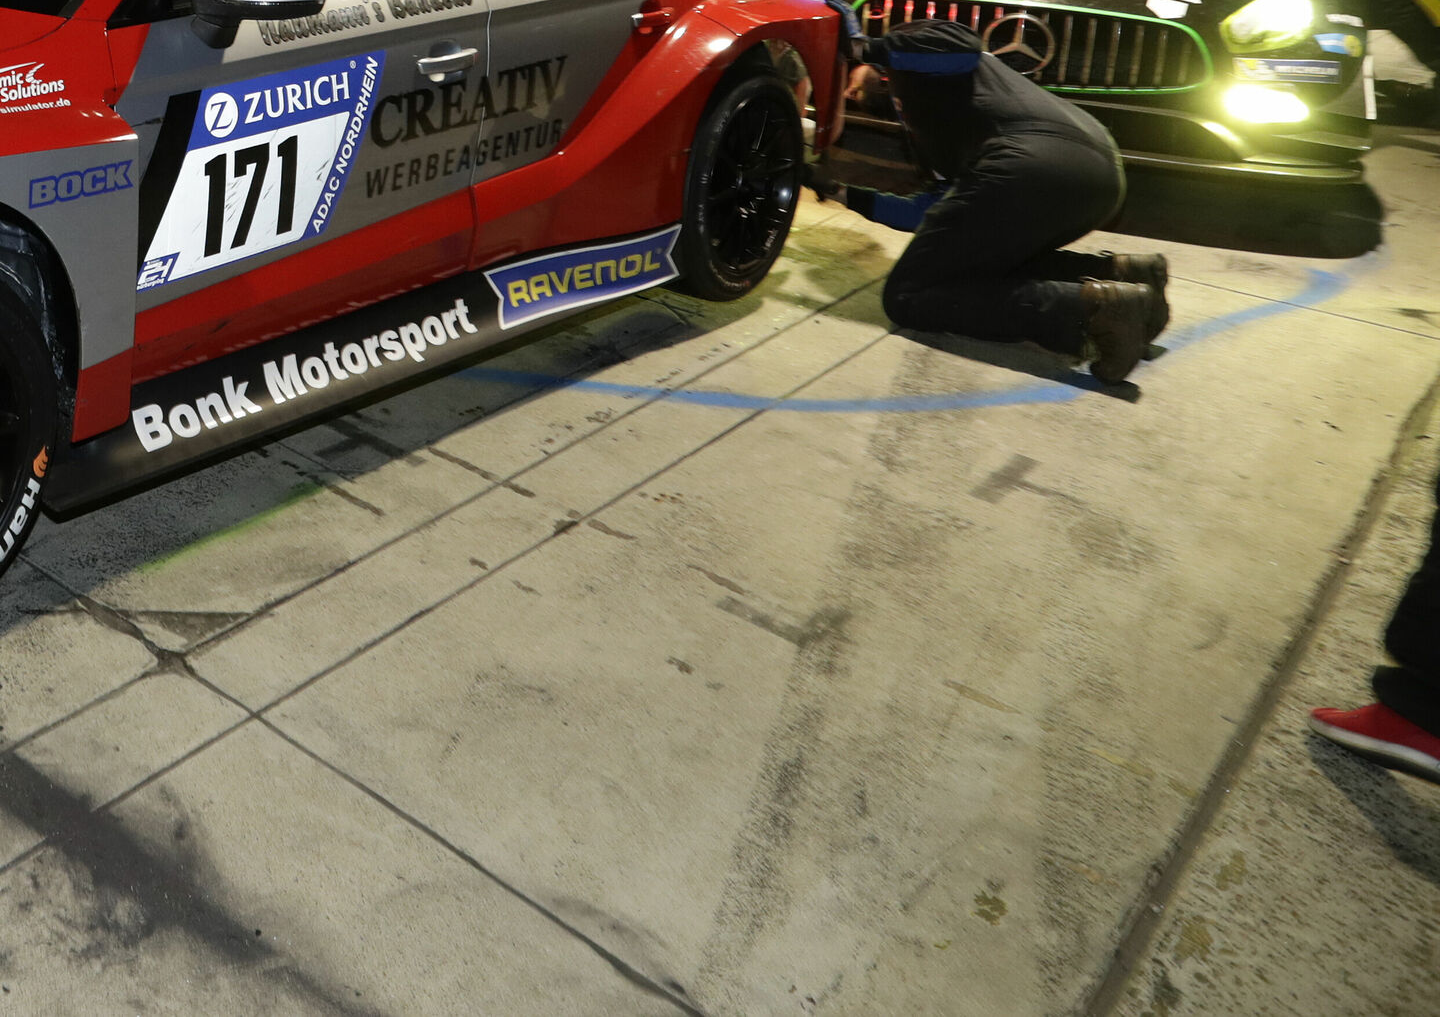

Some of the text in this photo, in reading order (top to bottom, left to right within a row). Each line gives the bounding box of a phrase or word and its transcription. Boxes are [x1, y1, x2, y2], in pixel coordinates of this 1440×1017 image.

[244, 71, 351, 124] ZURICH
[370, 55, 568, 149] CREATIV
[29, 160, 133, 210] BOCK
[312, 55, 379, 234] ADAC NORDRHEIN
[365, 118, 563, 199] WERBEAGENTUR
[205, 135, 298, 258] 171
[507, 250, 662, 310] RAVENOL
[132, 299, 478, 453] Bonk Motorsport
